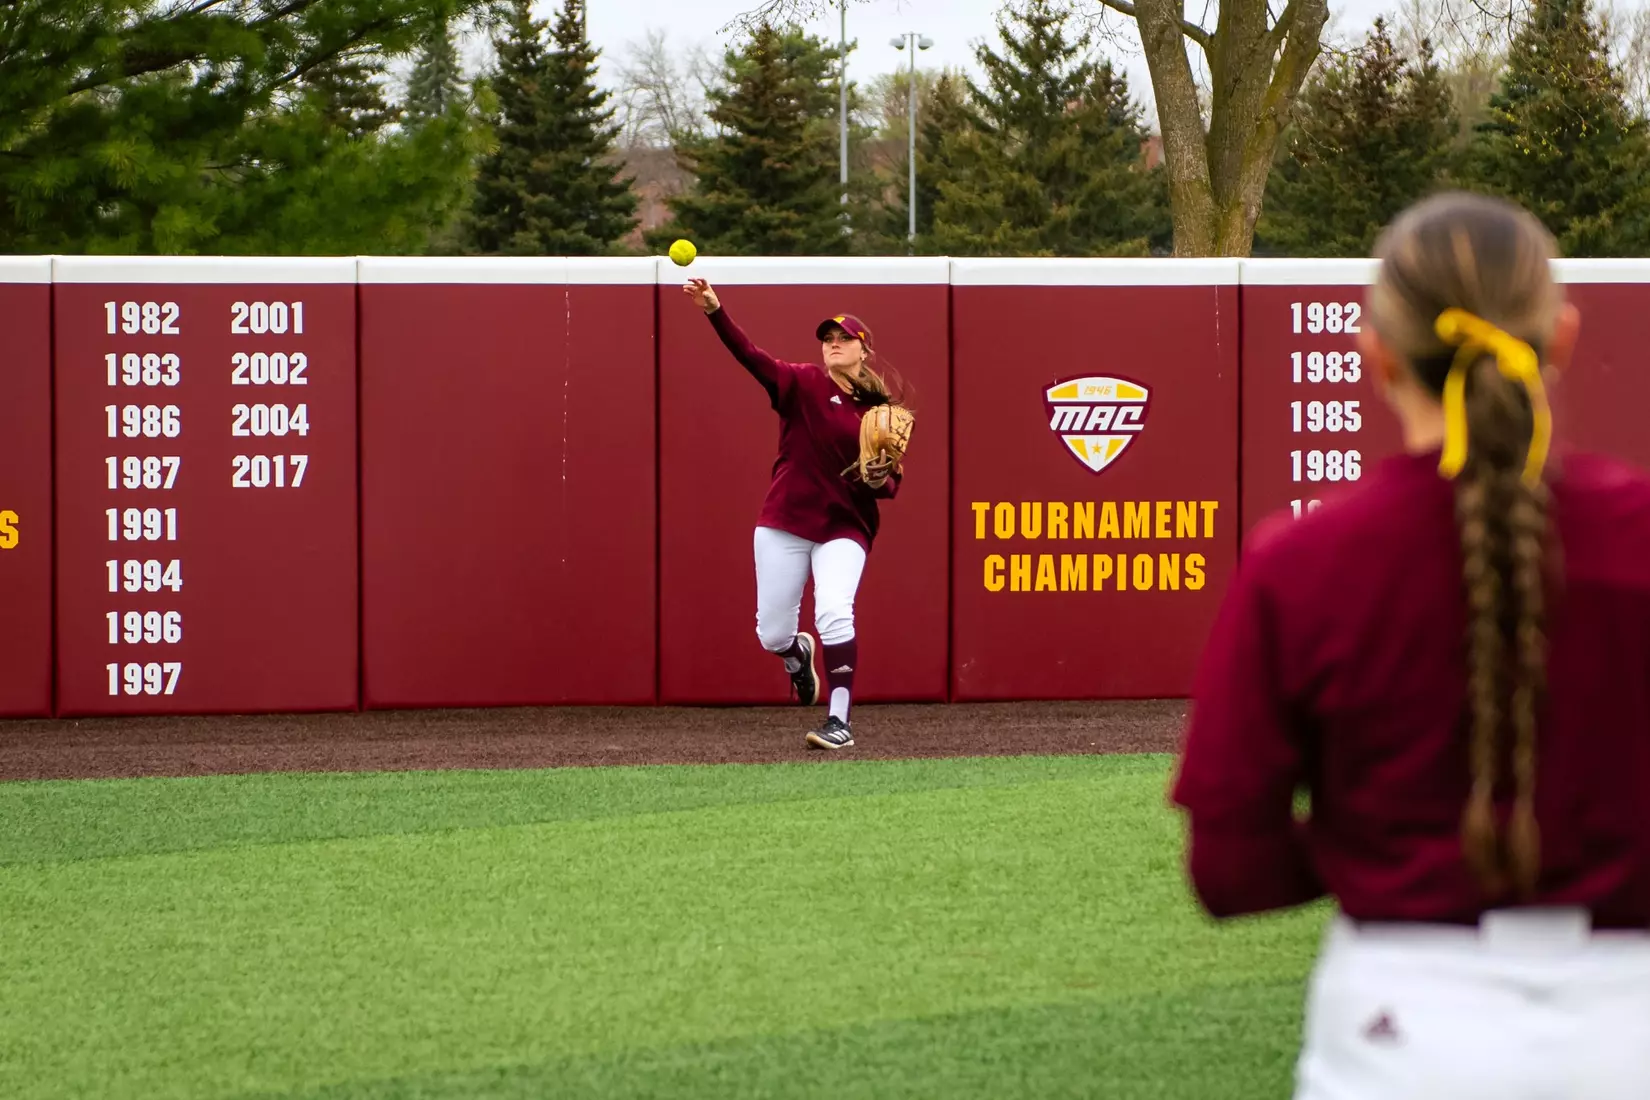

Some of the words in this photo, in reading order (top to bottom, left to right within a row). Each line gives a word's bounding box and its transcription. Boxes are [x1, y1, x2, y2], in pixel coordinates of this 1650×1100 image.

[105, 302, 180, 334] 1982
[231, 302, 303, 334] 2001
[1291, 302, 1361, 333] 1982
[105, 353, 180, 386] 1983
[232, 352, 308, 385] 2002
[1291, 351, 1361, 382] 1983
[1084, 386, 1112, 395] 1946
[105, 405, 180, 437] 1986
[232, 404, 309, 436] 2004
[1050, 406, 1144, 430] MAC
[1291, 401, 1361, 432] 1985
[106, 456, 180, 489] 1987
[232, 455, 308, 487] 2017
[1291, 450, 1361, 481] 1986
[106, 508, 176, 540] 1991
[972, 501, 1218, 539] TOURNAMENT
[106, 560, 182, 592] 1994
[984, 554, 1205, 591] CHAMPIONS
[106, 611, 181, 643] 1996
[107, 663, 181, 695] 1997
